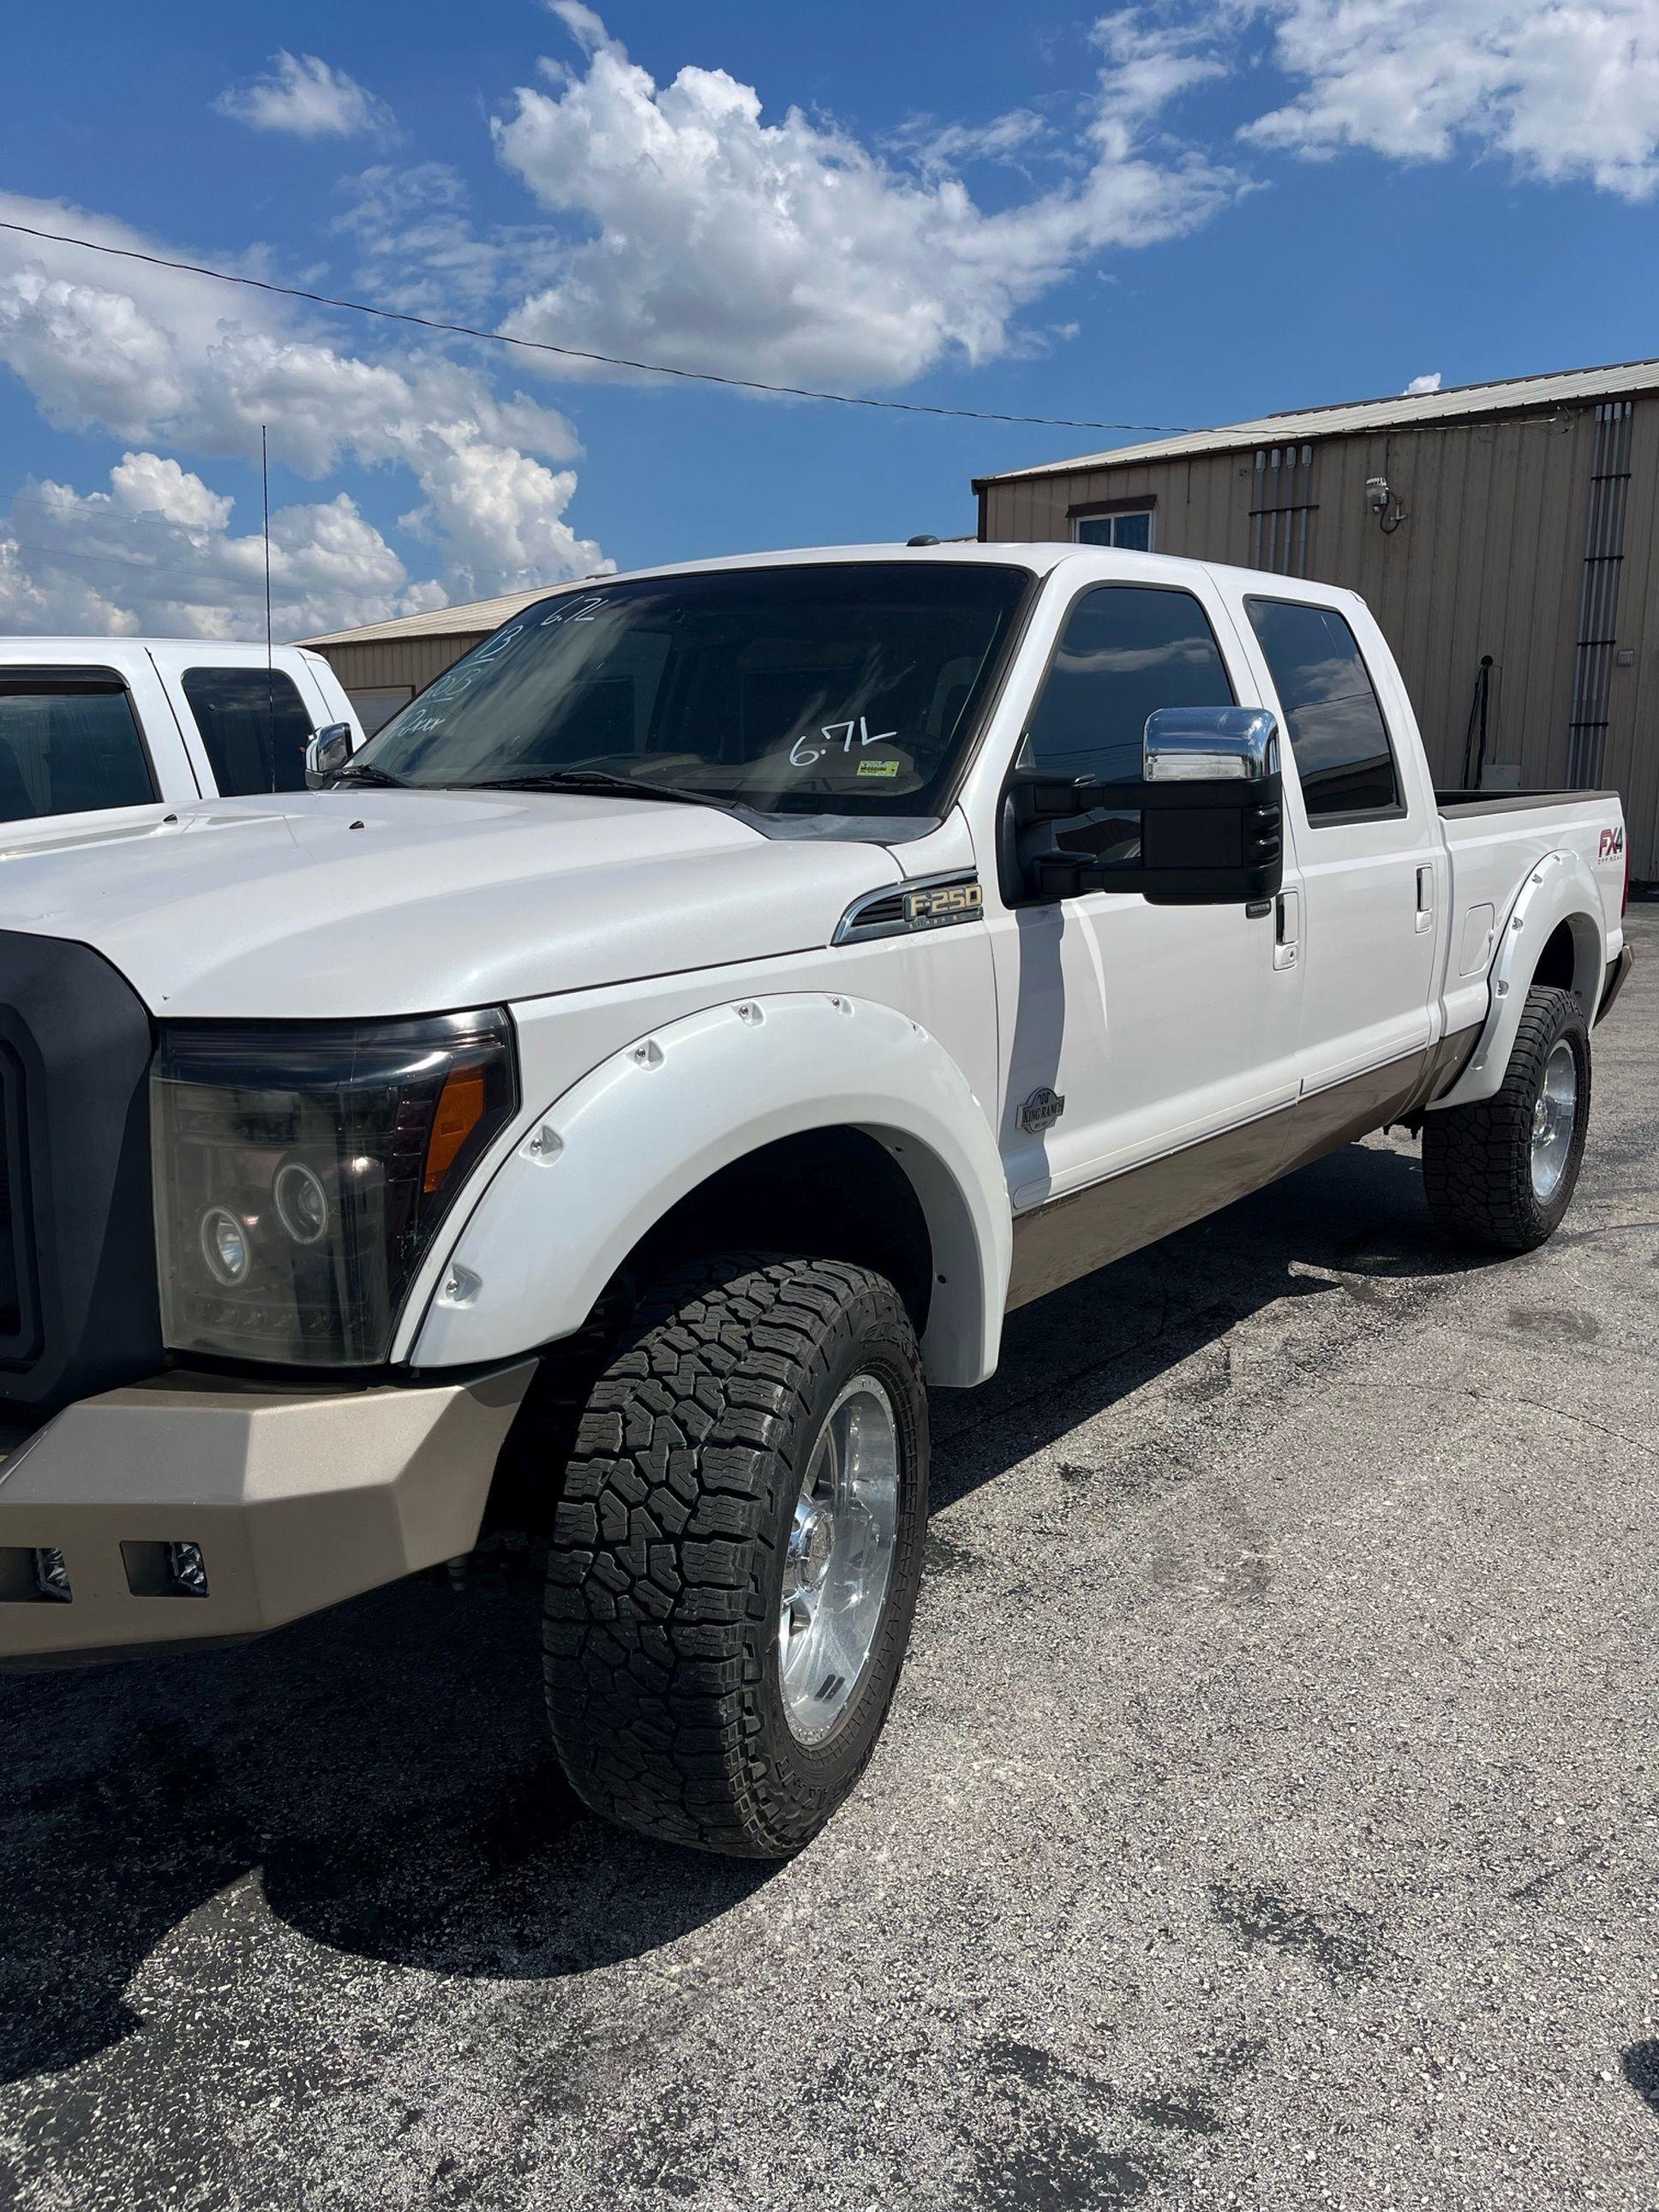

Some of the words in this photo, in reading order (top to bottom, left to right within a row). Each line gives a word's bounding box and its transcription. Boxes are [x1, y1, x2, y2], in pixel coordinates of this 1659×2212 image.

[789, 716, 897, 766] 6.7L
[1598, 826, 1623, 858] FX4
[908, 884, 983, 918] F-250
[1023, 1107, 1041, 1123] KING
[1041, 1099, 1063, 1119] RANCH
